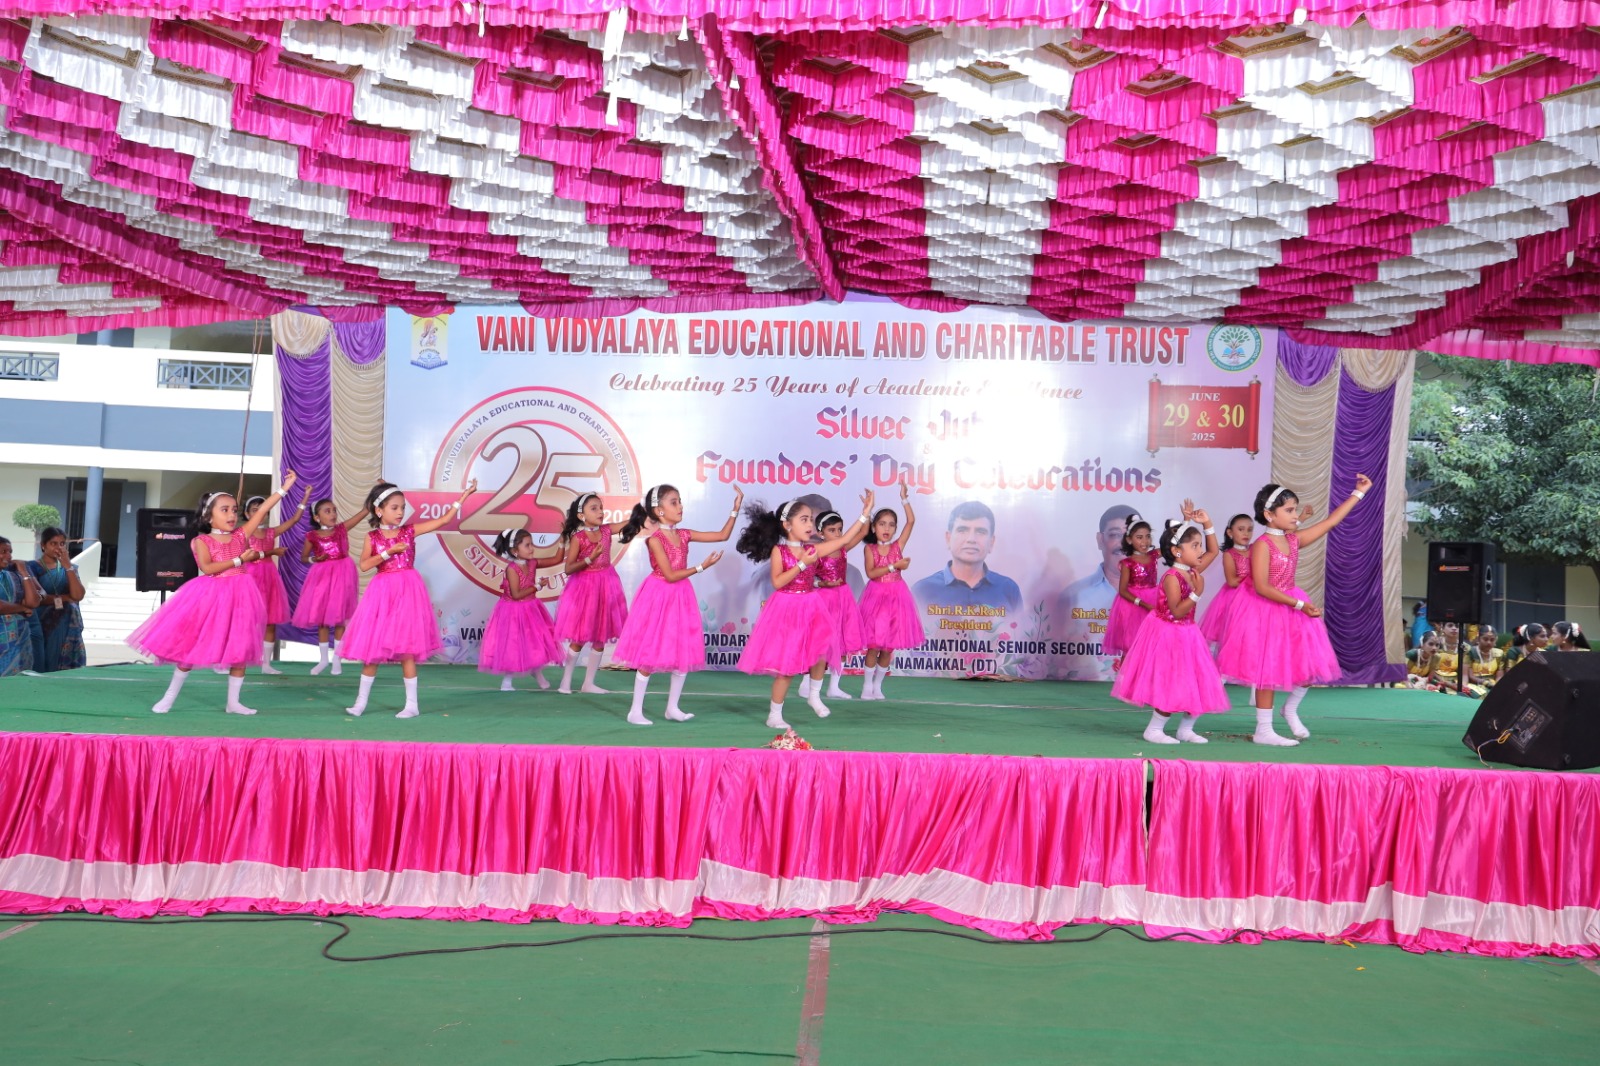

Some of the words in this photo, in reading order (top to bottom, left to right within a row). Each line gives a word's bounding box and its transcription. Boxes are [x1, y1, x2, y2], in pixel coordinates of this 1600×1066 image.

[476, 315, 535, 352] VANI
[545, 317, 679, 354] VIDYALAYA
[688, 319, 865, 358] EDUCATIONAL
[873, 321, 926, 359] AND
[936, 323, 1095, 362] CHARITABLE
[1105, 326, 1190, 364] TRUST
[609, 373, 725, 396] Celebrating
[731, 377, 758, 393] 25
[766, 376, 828, 397] Years
[836, 377, 860, 397] of
[864, 377, 970, 396] Academic
[1188, 392, 1221, 401] JUNE
[816, 405, 912, 440] Silver
[1163, 403, 1190, 428] 29
[1196, 410, 1211, 428] &
[1218, 404, 1245, 428] 30
[442, 459, 454, 482] VANI
[451, 415, 489, 458] VIDYALAYA
[489, 399, 555, 418] EDUCATIONAL
[557, 402, 577, 415] AND
[578, 411, 622, 460] CHARITABLE
[618, 461, 630, 493] TRUST
[1191, 432, 1216, 441] 2025
[870, 453, 936, 495] Day
[458, 425, 605, 548] 25
[928, 604, 1006, 617] Shri.R.K.Ravi
[940, 619, 993, 631] President
[998, 640, 1046, 655] SENIOR
[895, 656, 967, 671] NAMAKKAL
[971, 658, 998, 674] (DT)
